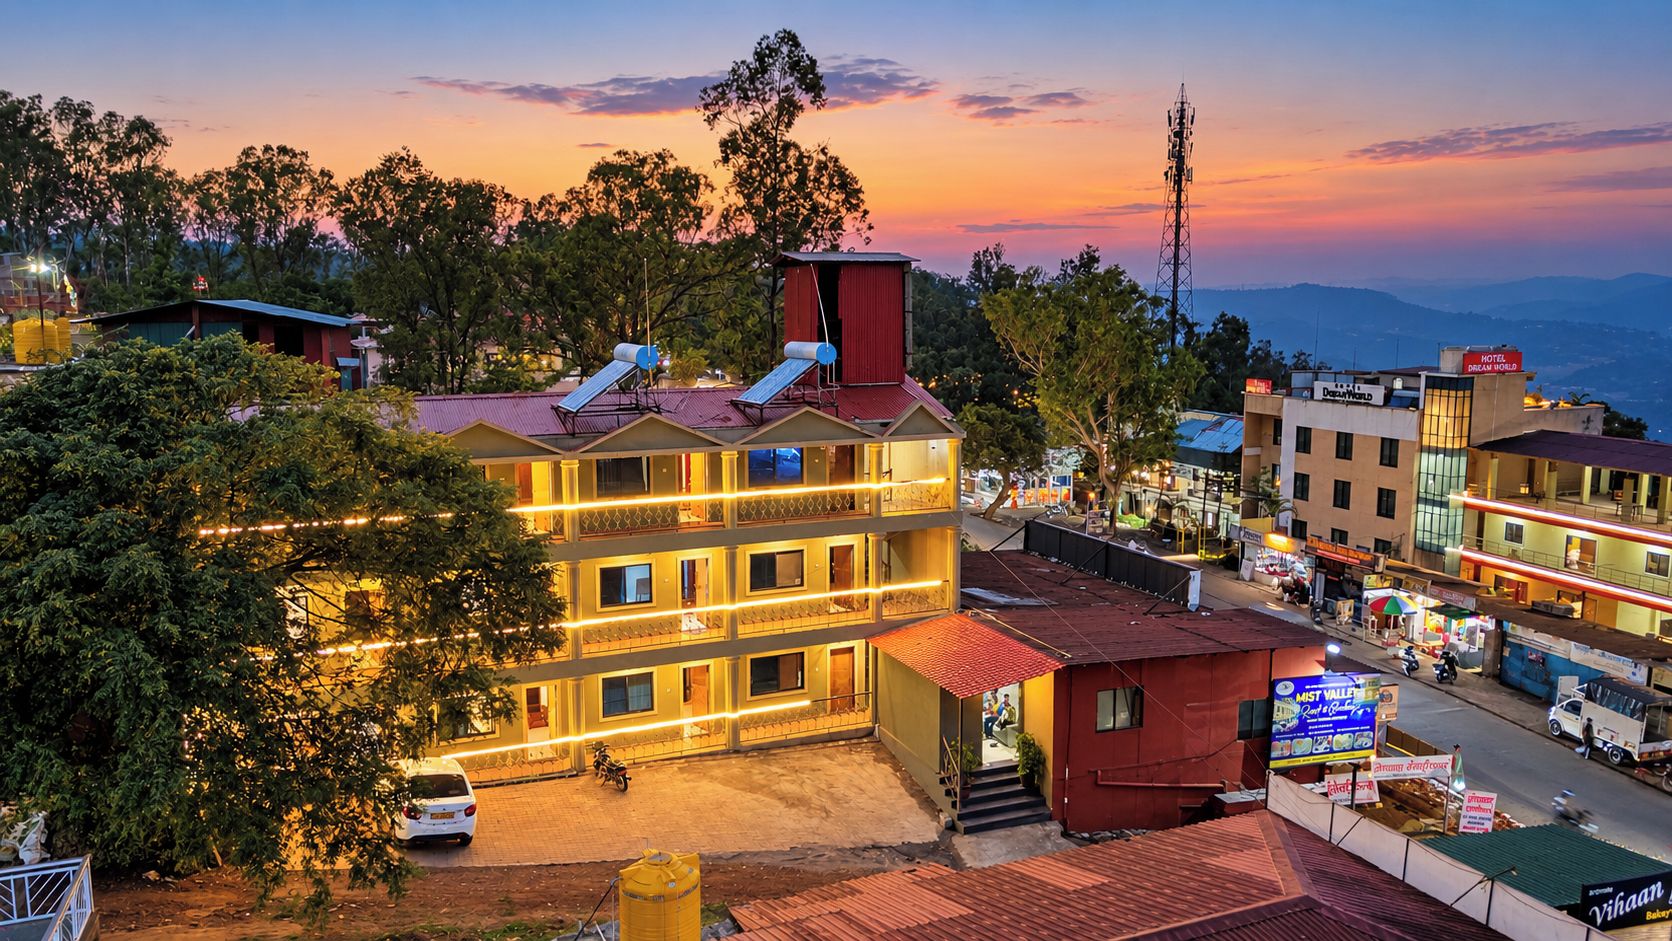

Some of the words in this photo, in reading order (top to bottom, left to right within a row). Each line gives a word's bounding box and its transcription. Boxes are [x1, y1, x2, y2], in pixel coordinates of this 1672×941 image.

[1481, 354, 1506, 363] HOTEL
[1468, 364, 1492, 372] DREAM
[1494, 363, 1517, 371] WORLD
[1296, 691, 1322, 703] MIST
[1589, 881, 1664, 926] Vihaan
